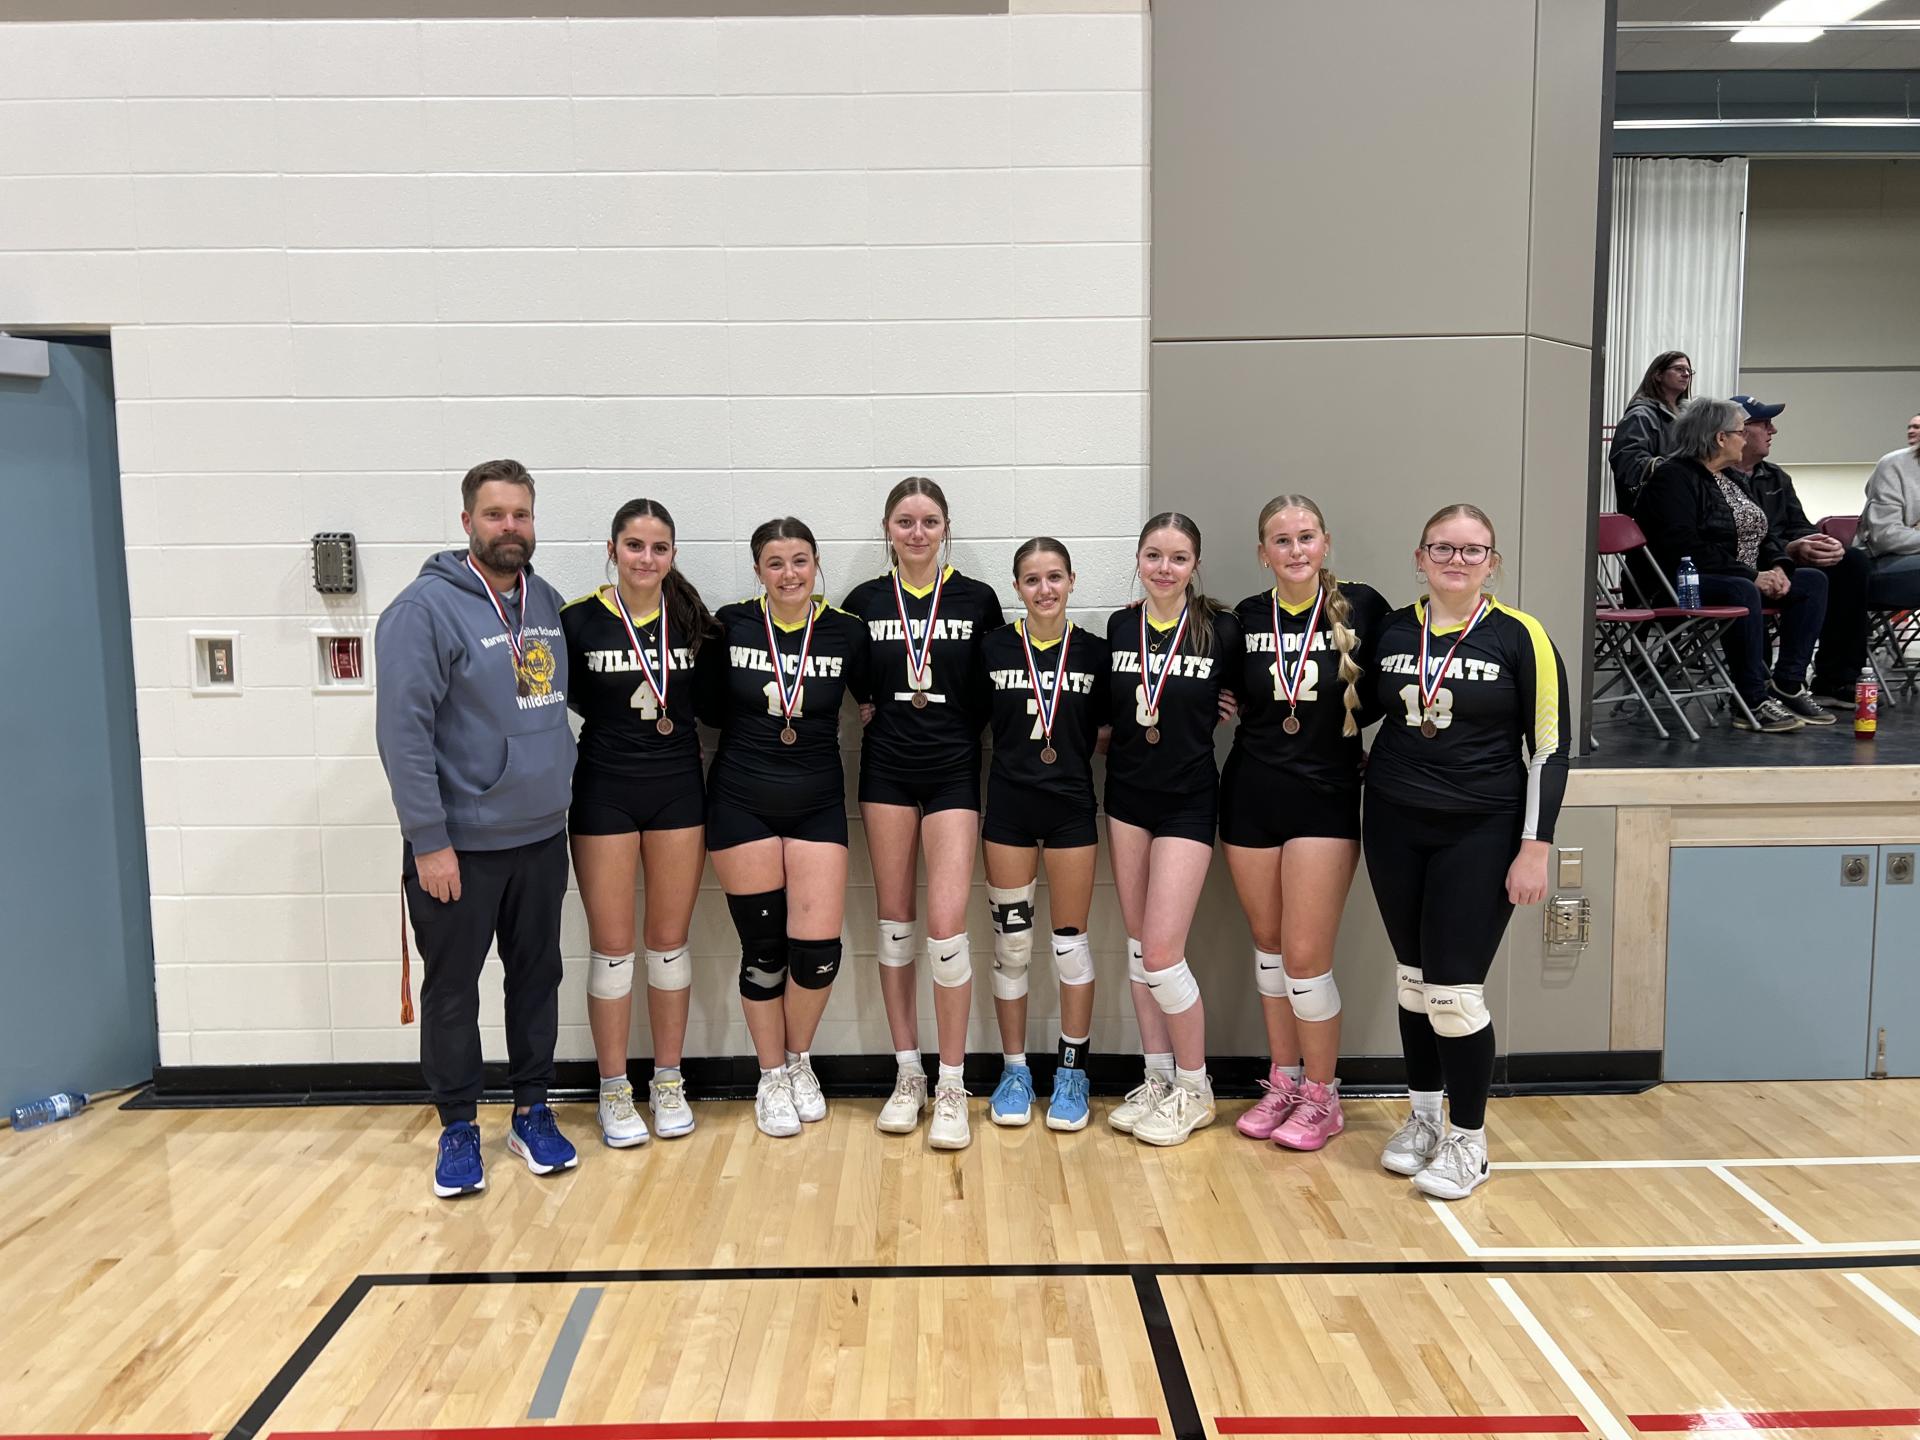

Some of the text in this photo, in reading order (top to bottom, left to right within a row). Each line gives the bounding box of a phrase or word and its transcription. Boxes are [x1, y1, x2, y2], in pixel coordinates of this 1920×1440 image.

[868, 619, 974, 641] WILDCATS
[1245, 629, 1356, 653] WILDCAT
[584, 648, 695, 673] WILDCATS
[729, 646, 843, 677] WILDCATS
[907, 649, 933, 691] 6
[1112, 650, 1214, 679] WILDCATS
[1380, 653, 1501, 681] WILDCATS
[989, 669, 1095, 694] WILDCATS
[1268, 659, 1319, 702] 12
[515, 690, 565, 710] Wildcats
[630, 680, 658, 720] 4
[1398, 684, 1454, 729] 18
